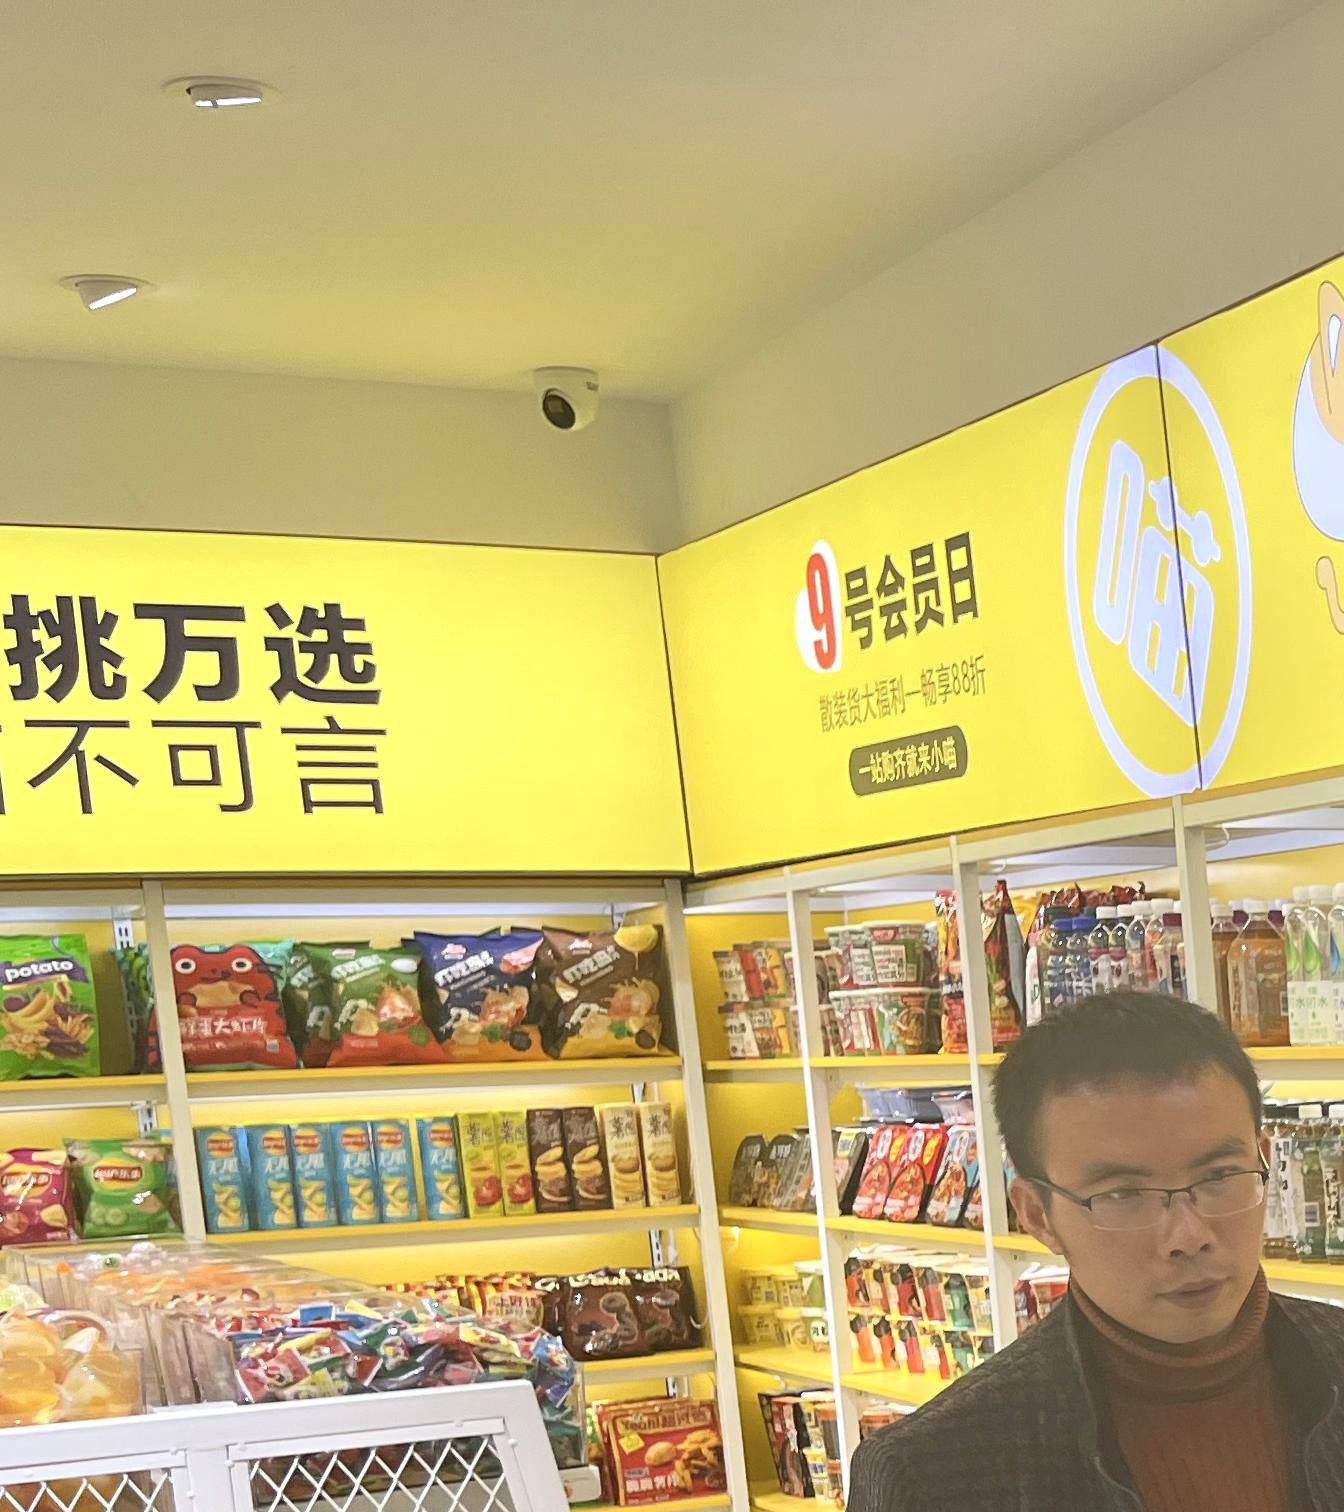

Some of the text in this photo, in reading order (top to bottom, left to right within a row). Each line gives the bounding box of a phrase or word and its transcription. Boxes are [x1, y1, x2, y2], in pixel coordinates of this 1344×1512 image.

[2, 593, 383, 705] 挑万选
[0, 715, 388, 816] 不可言
[5, 958, 74, 982] potato
